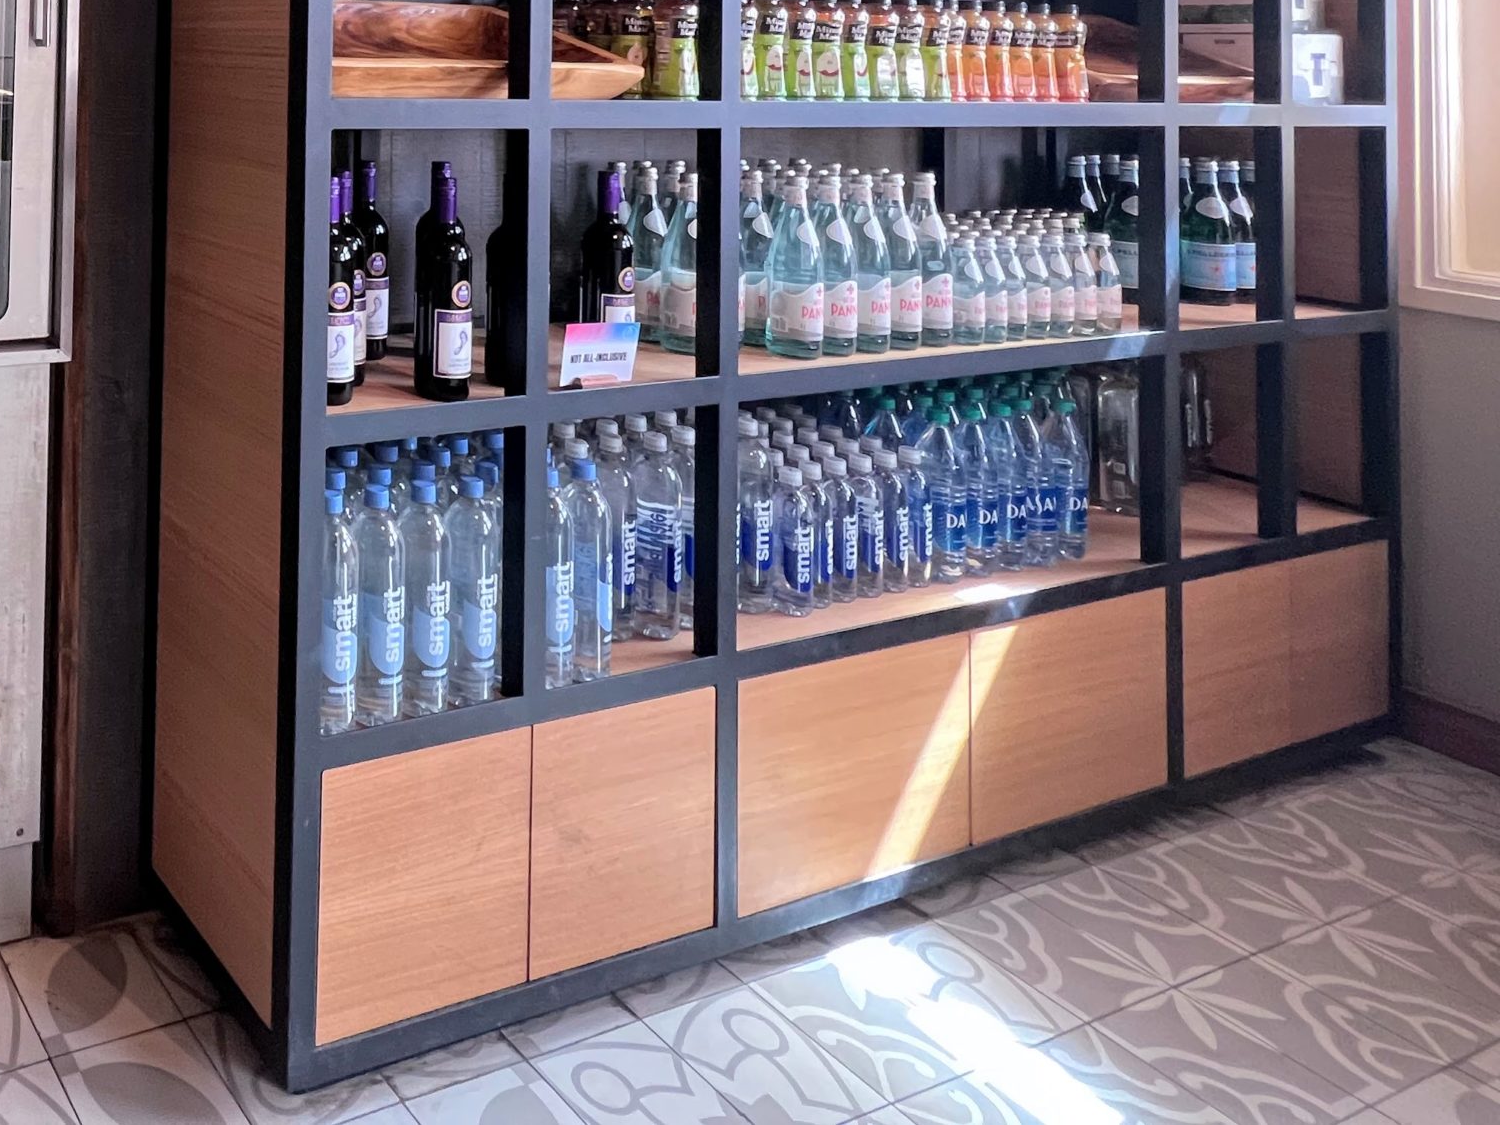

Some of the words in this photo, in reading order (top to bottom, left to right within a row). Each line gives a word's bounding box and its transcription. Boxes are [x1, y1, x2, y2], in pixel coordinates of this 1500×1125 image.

[622, 519, 636, 586] smart
[754, 499, 771, 562] smart
[795, 526, 811, 584] smart
[843, 515, 857, 571] smart
[384, 586, 401, 663] smart
[427, 581, 446, 656] smart
[477, 574, 494, 648] smart
[553, 561, 570, 632] smart
[333, 594, 353, 672] smart
